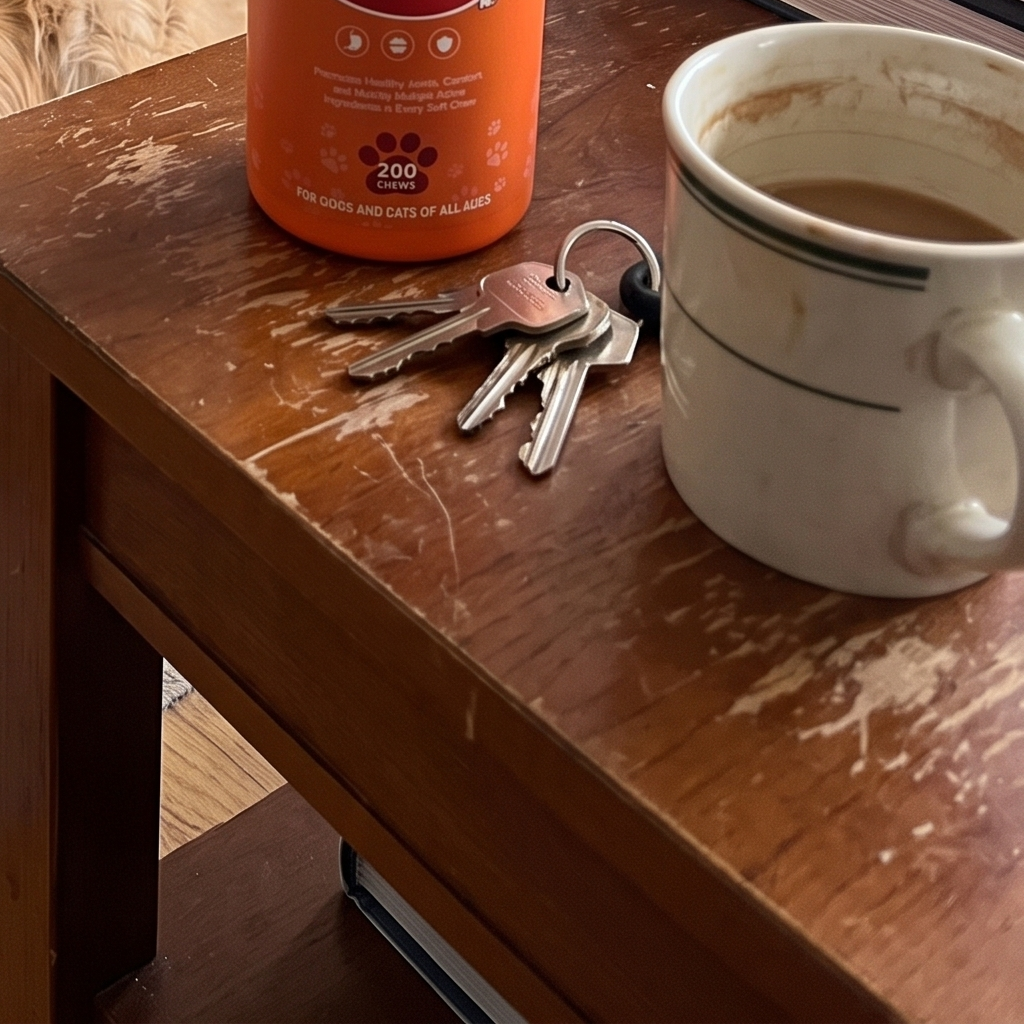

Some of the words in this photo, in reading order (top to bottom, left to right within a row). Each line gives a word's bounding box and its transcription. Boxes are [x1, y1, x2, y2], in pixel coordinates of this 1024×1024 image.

[377, 162, 417, 179] 200
[377, 180, 416, 190] CHEWS
[296, 186, 317, 203] FOR
[356, 204, 383, 217] AND
[386, 206, 417, 218] CATS
[420, 205, 436, 218] OF
[439, 202, 461, 216] ALL
